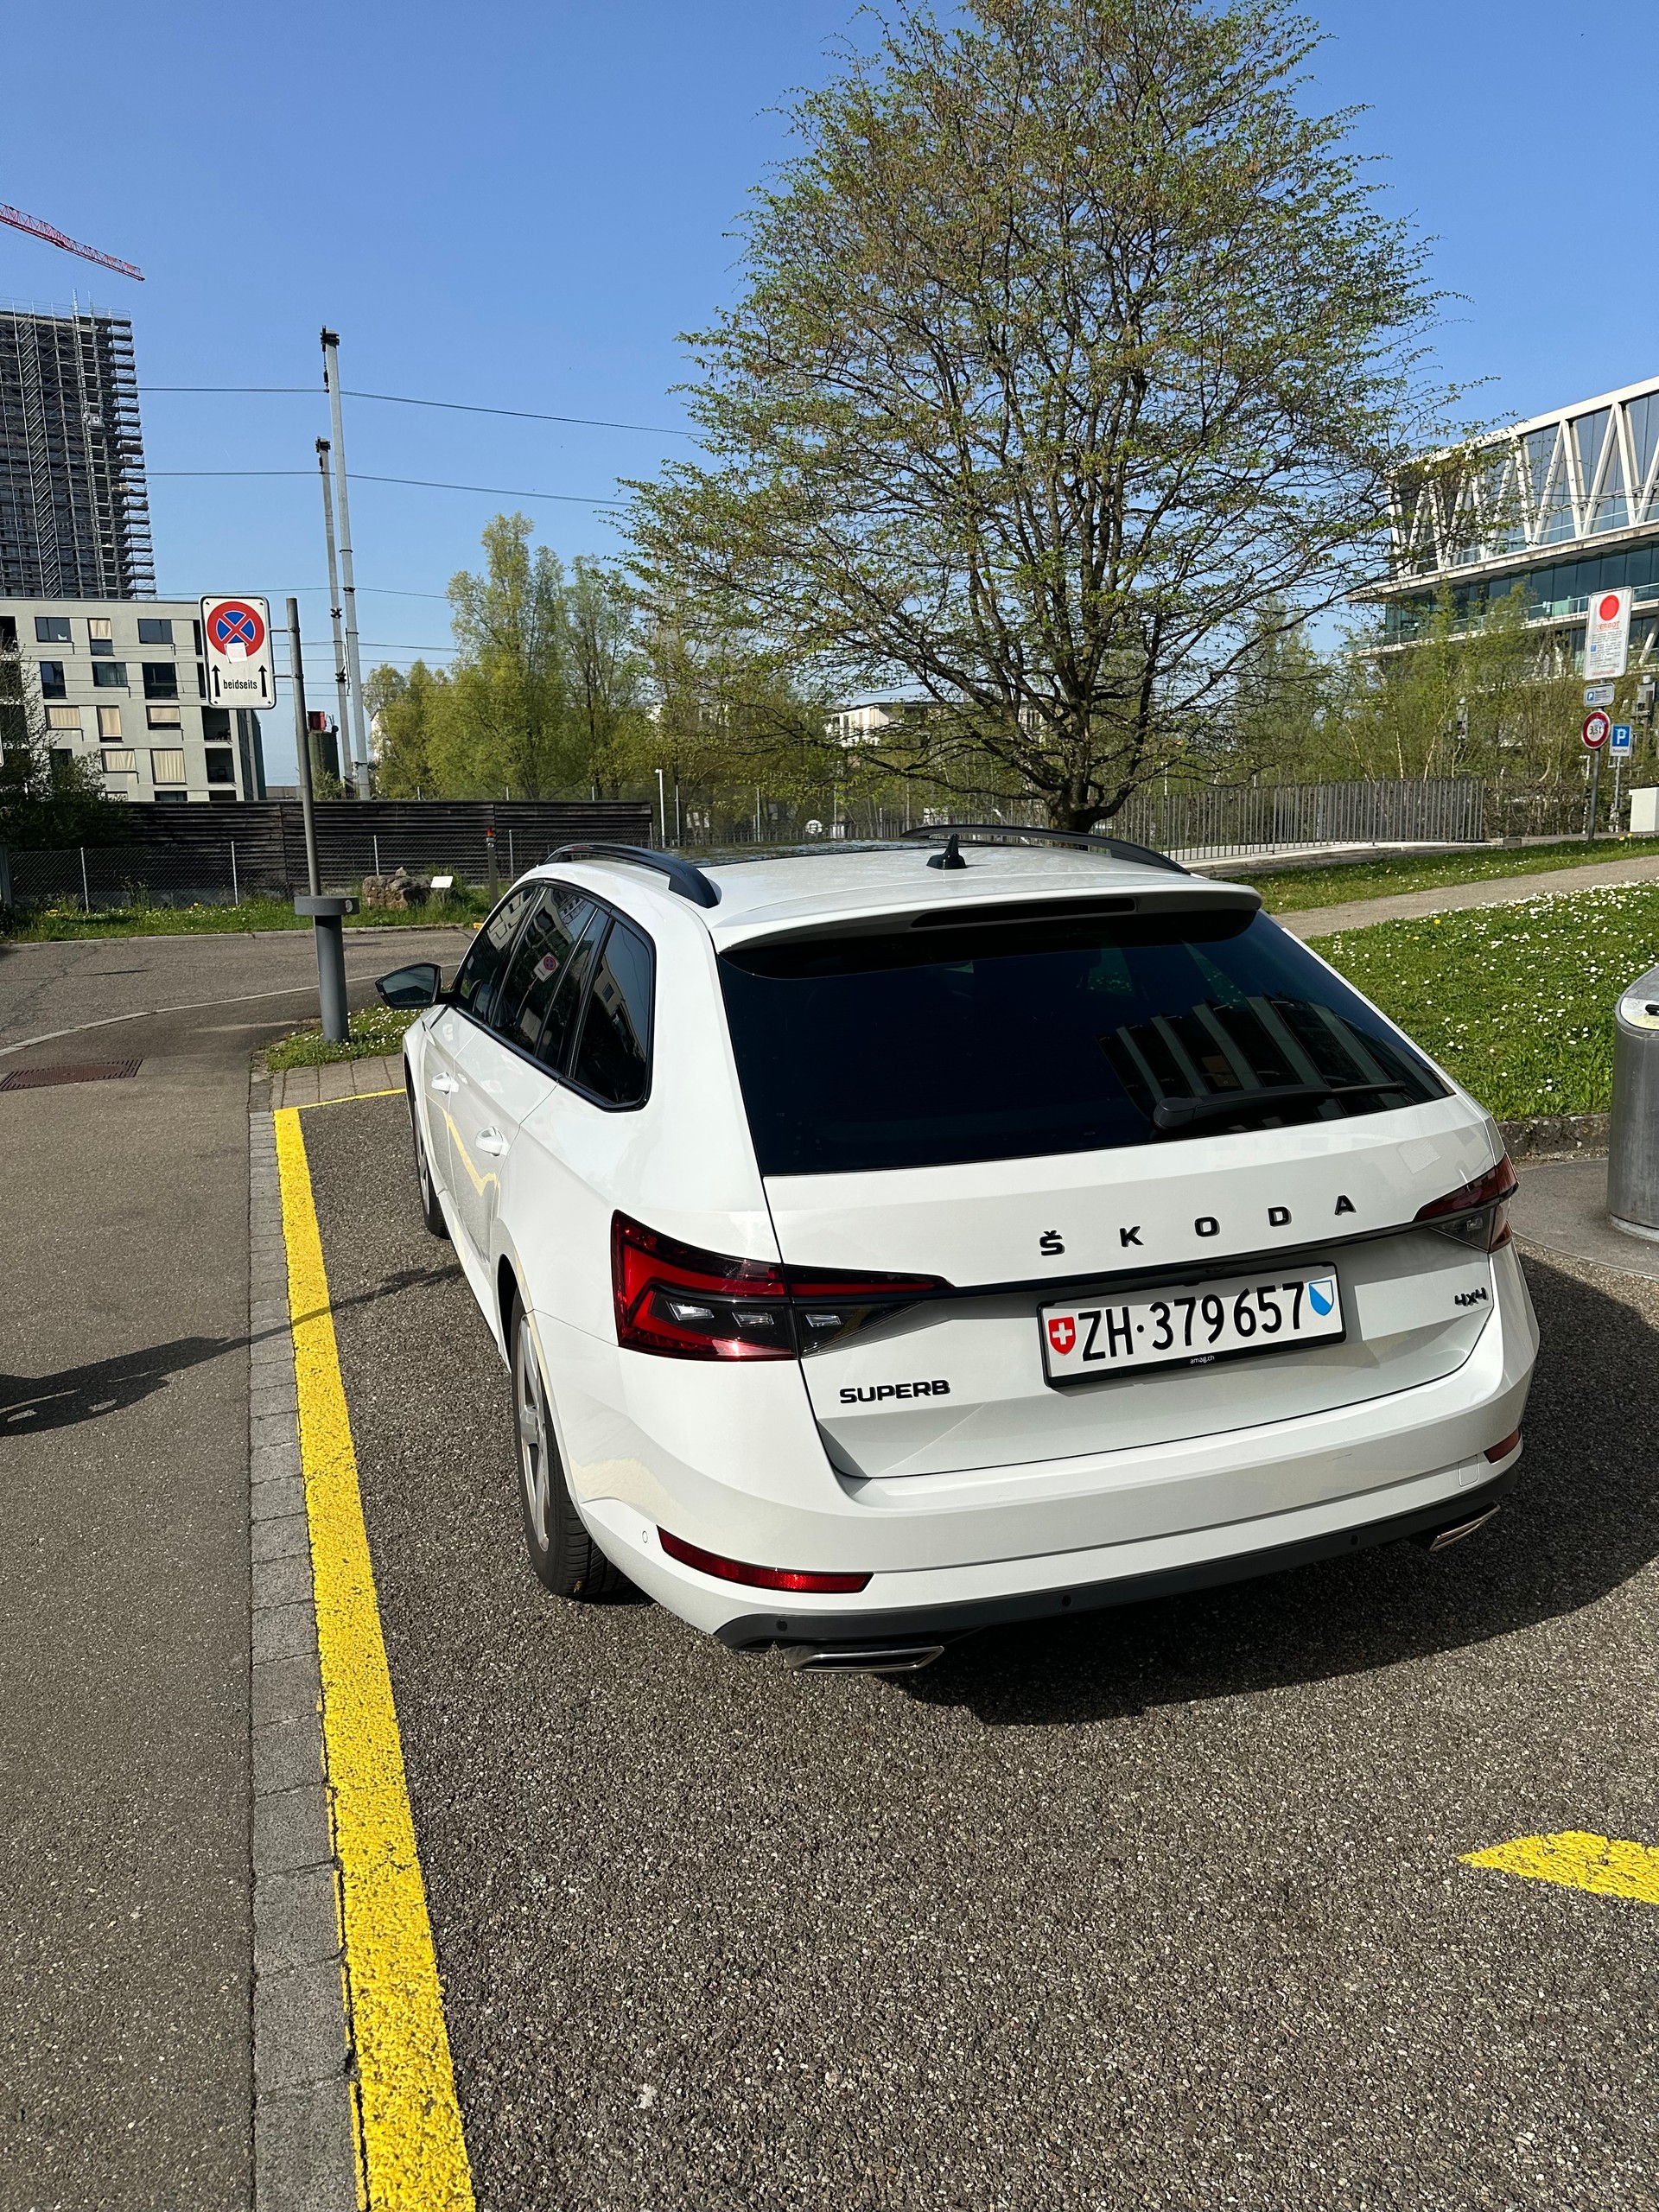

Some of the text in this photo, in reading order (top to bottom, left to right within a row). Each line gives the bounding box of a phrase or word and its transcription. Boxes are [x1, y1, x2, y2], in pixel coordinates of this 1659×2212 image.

[223, 679, 257, 690] beidseits
[1617, 728, 1627, 745] P
[1039, 1194, 1357, 1256] ŠKODA
[1190, 1355, 1215, 1364] amag.ch
[839, 1379, 950, 1404] SUPERB
